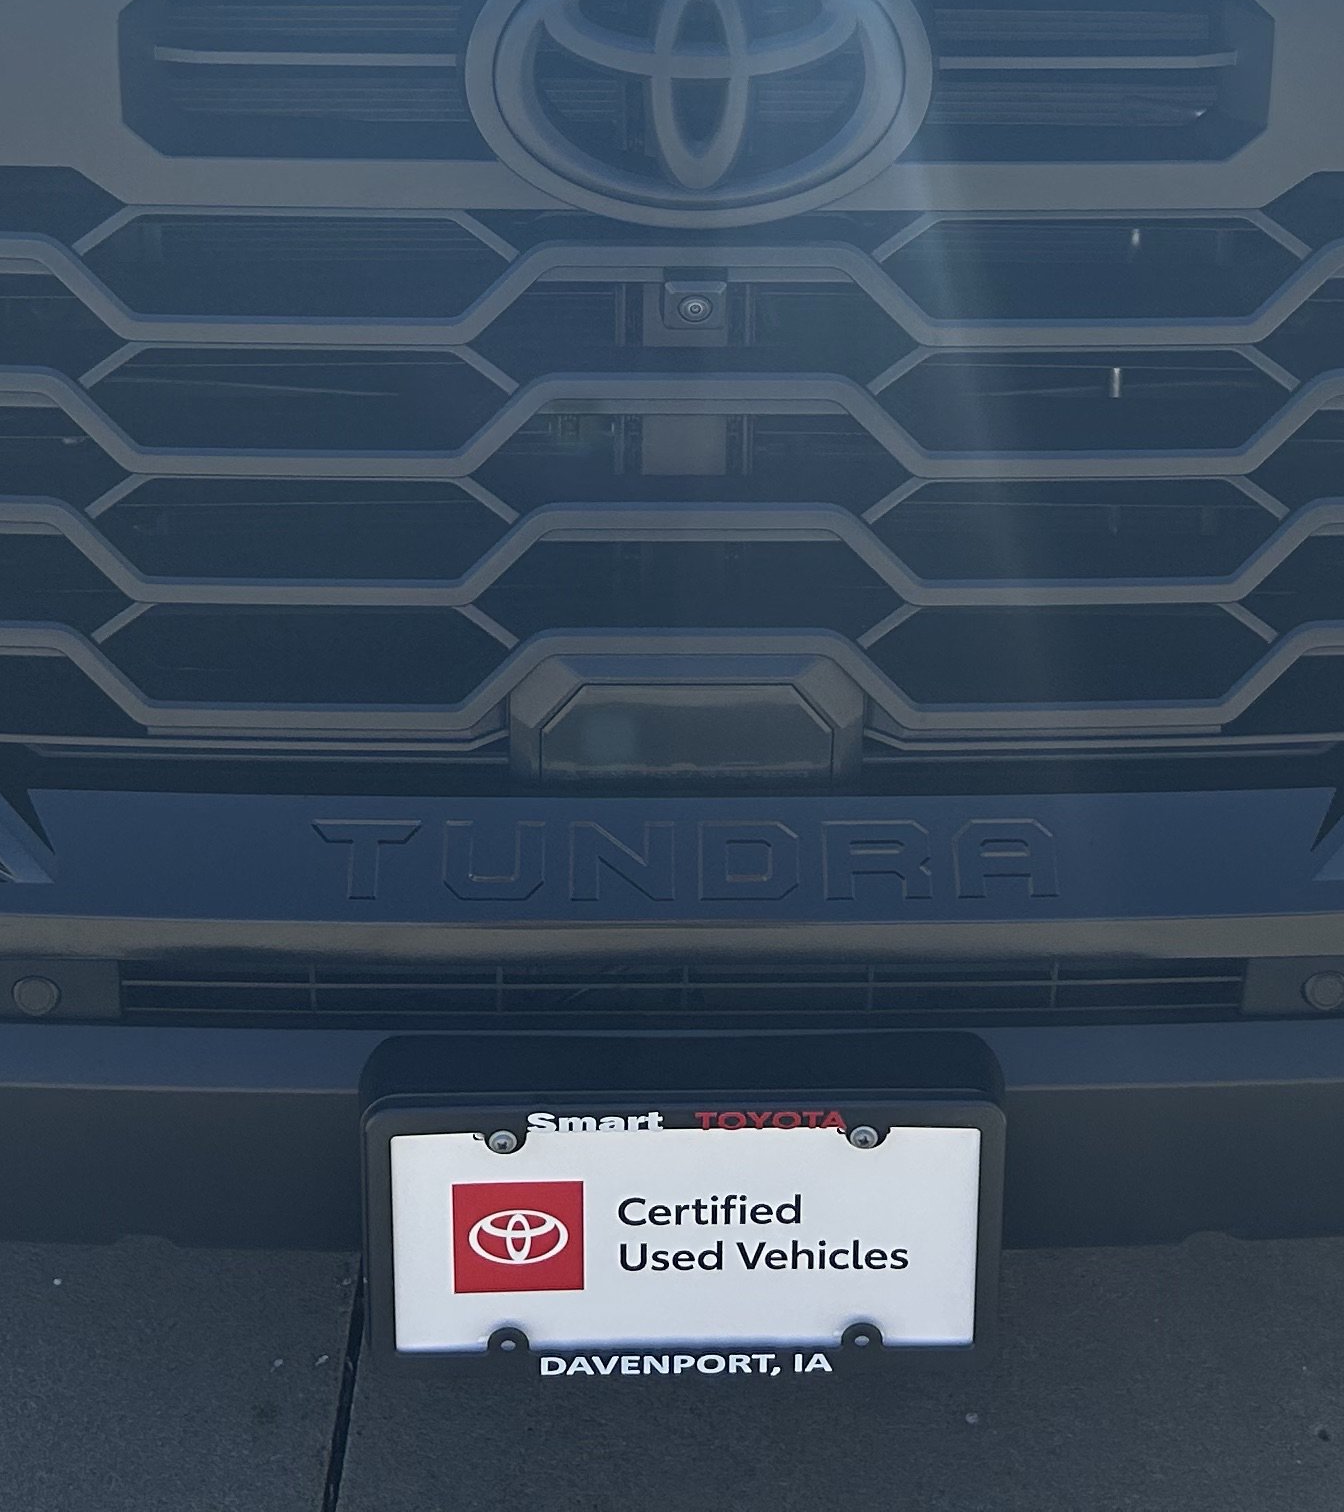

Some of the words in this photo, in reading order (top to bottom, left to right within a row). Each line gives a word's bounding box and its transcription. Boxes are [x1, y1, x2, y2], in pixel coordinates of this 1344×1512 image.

[310, 818, 1060, 902] TUNDRA
[527, 1111, 664, 1133] Smart
[695, 1110, 847, 1130] TOYOTA
[618, 1193, 802, 1226] Certified
[619, 1240, 723, 1272] Used
[736, 1240, 909, 1271] Vehicles
[540, 1354, 781, 1377] DAVENPORT,
[794, 1353, 833, 1373] IA
